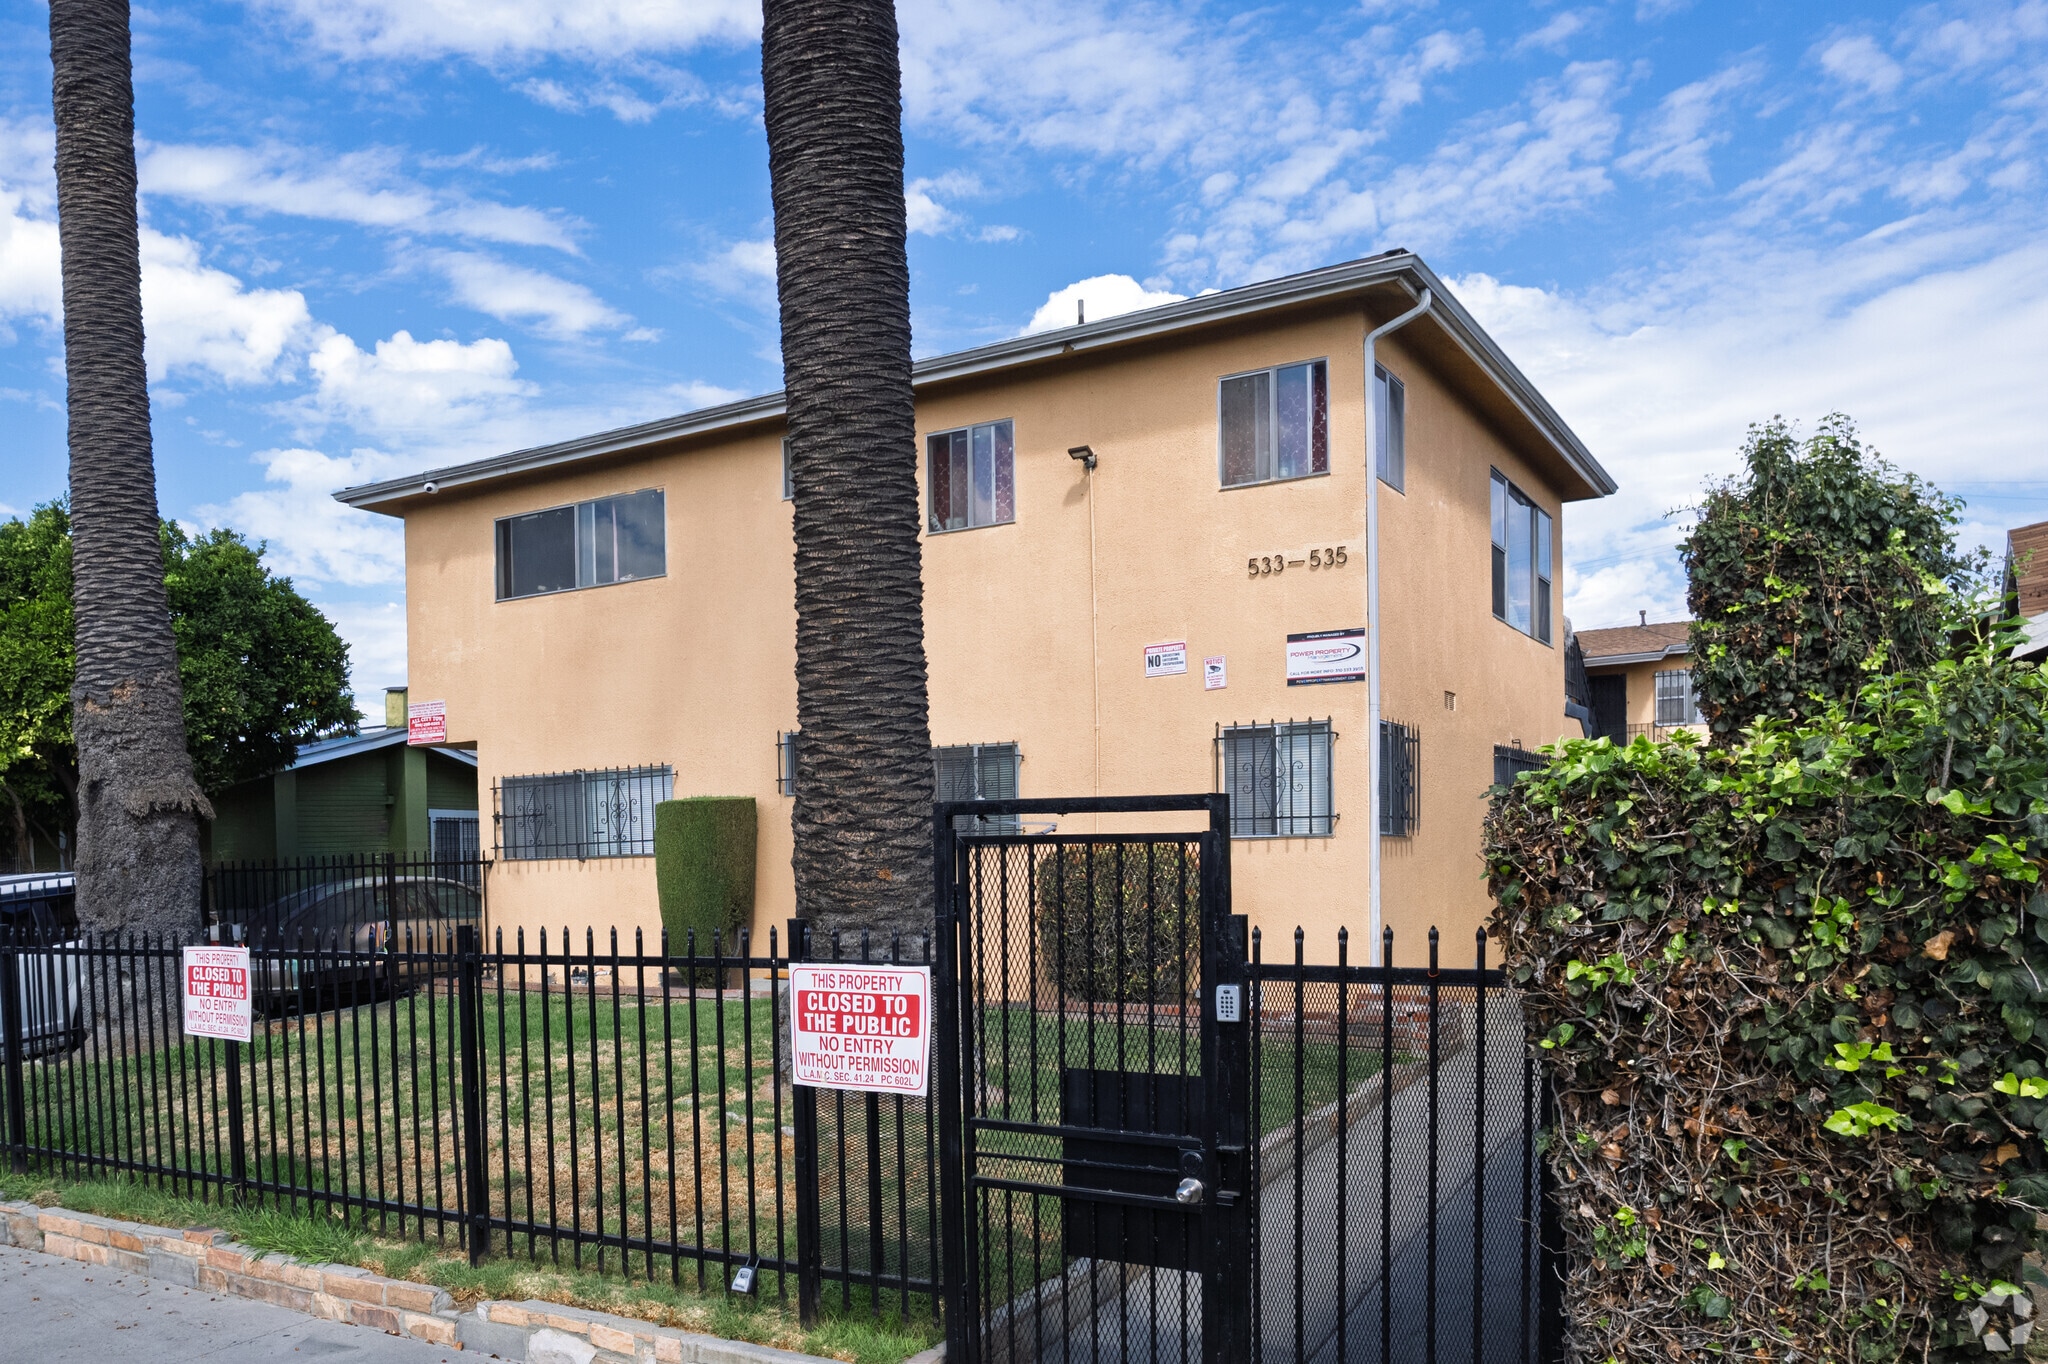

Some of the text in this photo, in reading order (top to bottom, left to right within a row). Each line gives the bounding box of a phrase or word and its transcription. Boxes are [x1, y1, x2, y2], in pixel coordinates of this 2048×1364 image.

[1148, 655, 1161, 668] NO
[195, 953, 238, 966] THIS PROPERTY
[193, 967, 242, 983] CLOSED TO
[811, 973, 903, 992] THIS PROPERTY
[191, 981, 244, 999] THE PUBLIC
[200, 998, 237, 1012] NO ENTRY
[806, 992, 908, 1015] CLOSED TO
[188, 1010, 247, 1027] WITHOUT PERMISSION
[803, 1013, 911, 1037] THE PUBLIC
[819, 1036, 894, 1055] NO ENTRY
[798, 1051, 920, 1076] WITHOUT PERMISSION
[804, 1069, 914, 1088] L.A.MC. SEC. 41.24 PC 602L
